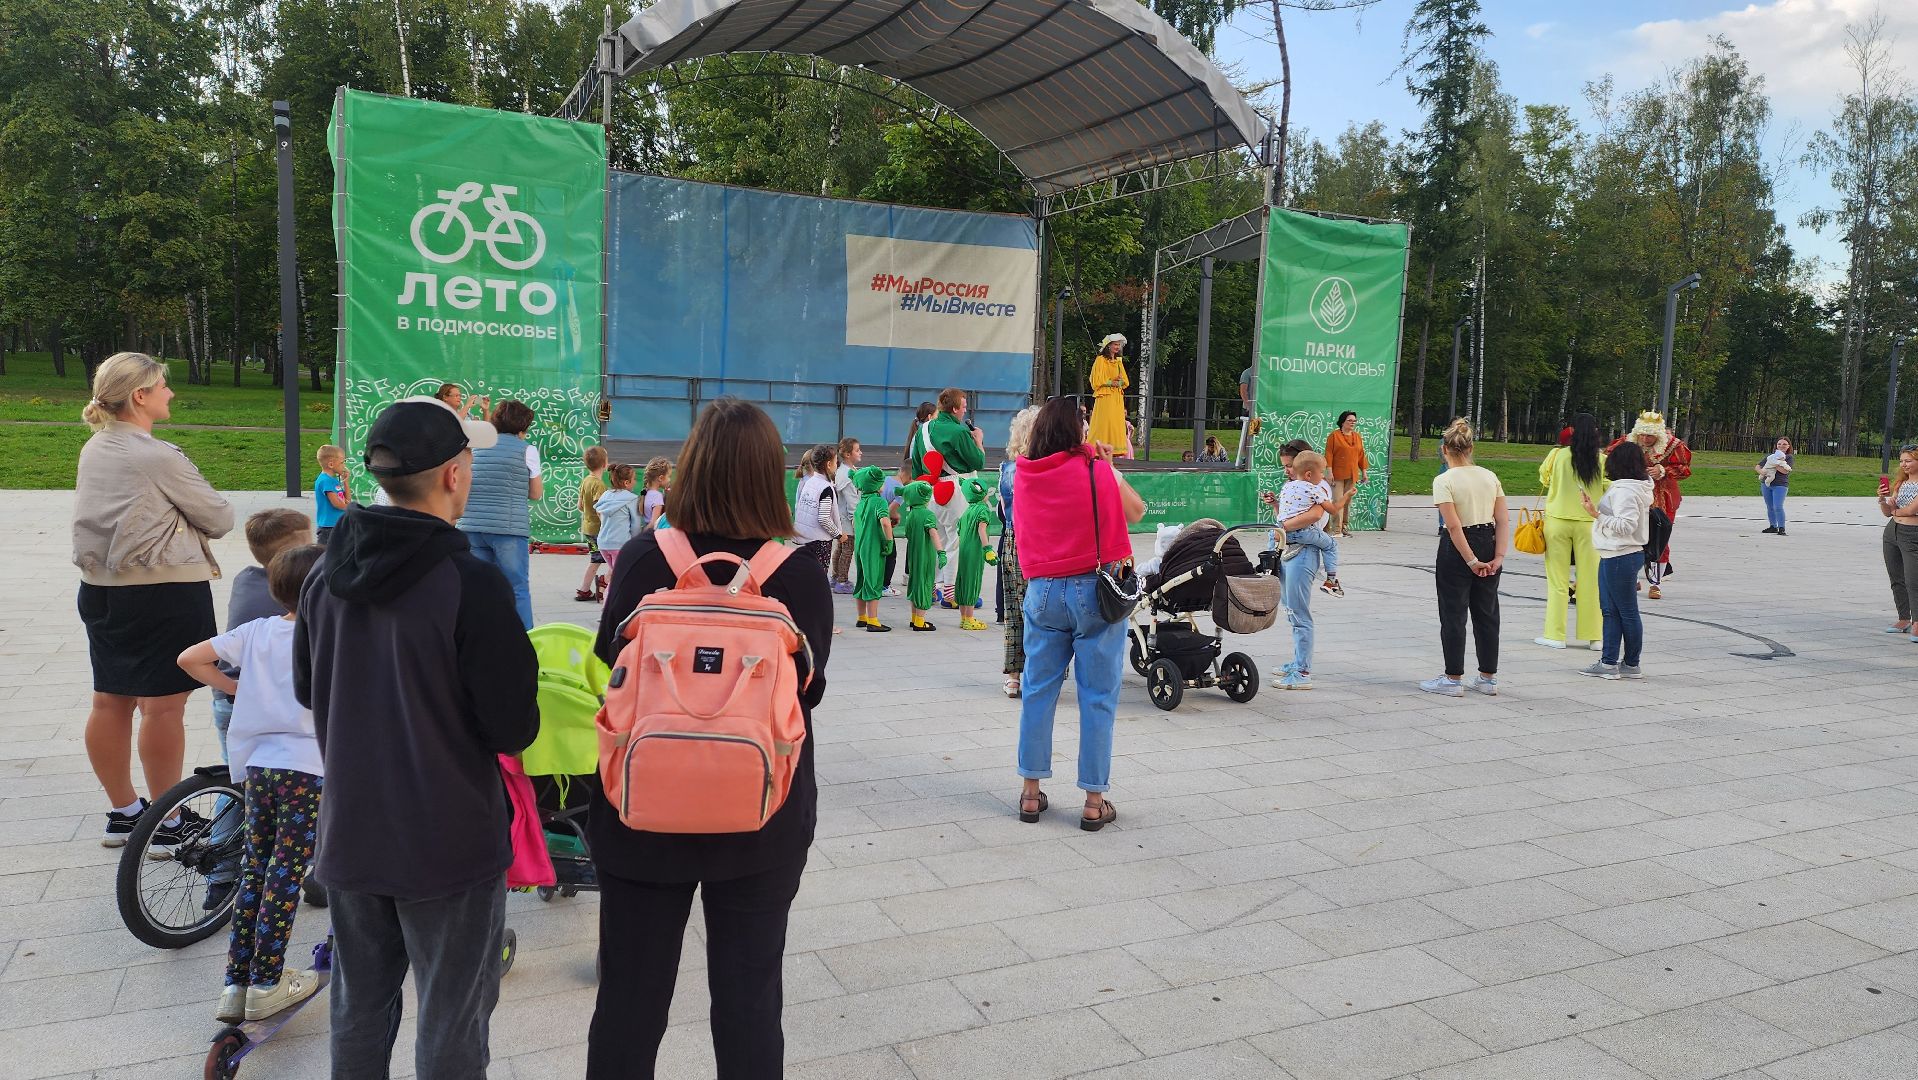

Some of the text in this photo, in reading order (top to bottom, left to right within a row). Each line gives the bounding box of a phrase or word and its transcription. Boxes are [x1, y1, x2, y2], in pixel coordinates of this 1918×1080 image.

[397, 271, 557, 316] лето
[870, 273, 990, 299] #МыРоссия
[900, 293, 1017, 317] #МыВместе
[417, 317, 557, 340] ПОДМОСКОВЬЕ
[1305, 341, 1356, 359] ПАРКИ
[1269, 356, 1386, 377] ПОДМОСКОВЬЯ
